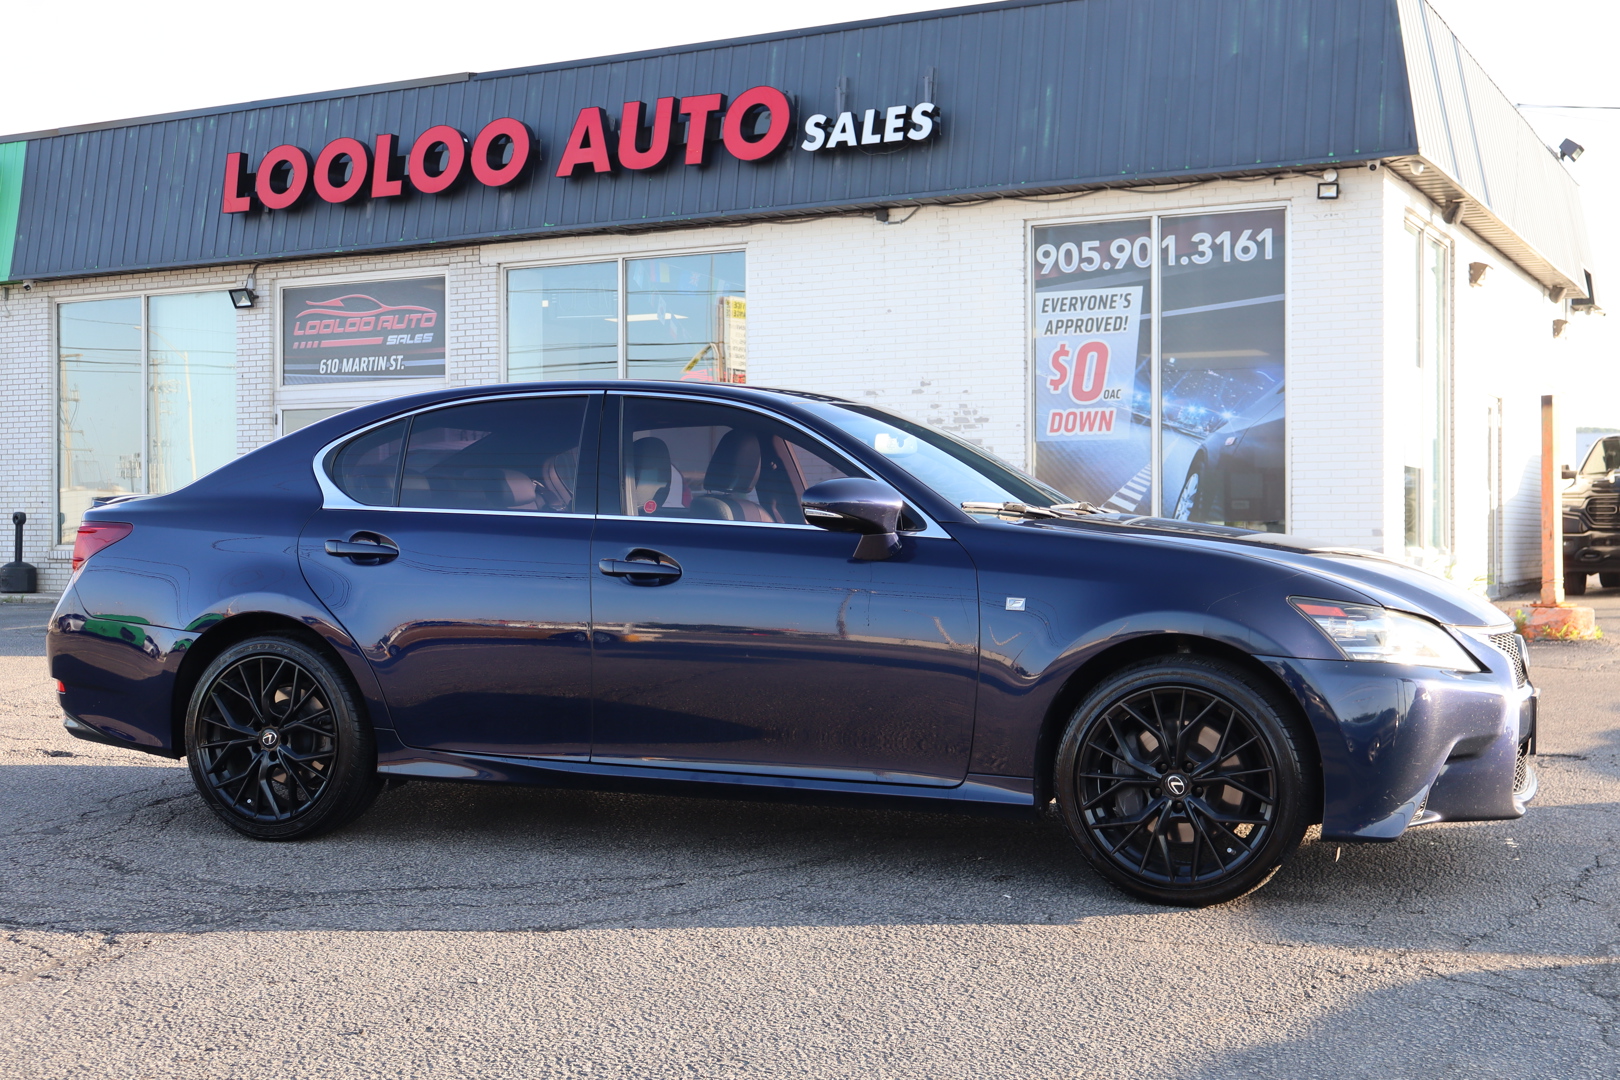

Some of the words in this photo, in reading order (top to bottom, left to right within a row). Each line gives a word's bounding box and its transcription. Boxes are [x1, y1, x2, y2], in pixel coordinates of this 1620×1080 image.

[222, 117, 531, 214] LOOLOO
[556, 86, 791, 178] AUTO
[801, 102, 935, 152] SALES
[1036, 227, 1273, 275] 905.901.3161
[1041, 293, 1132, 313] EVERYONE'S
[293, 317, 376, 336] LOOLOO
[377, 312, 438, 331] AUTO
[1044, 316, 1129, 335] APPROVED!
[386, 333, 434, 346] SALES
[319, 358, 340, 375] 610
[341, 356, 388, 374] MARTIN
[389, 355, 405, 371] ST.
[1049, 341, 1109, 402] $0
[1103, 388, 1122, 400] OAC
[1049, 410, 1114, 433] DOWN
